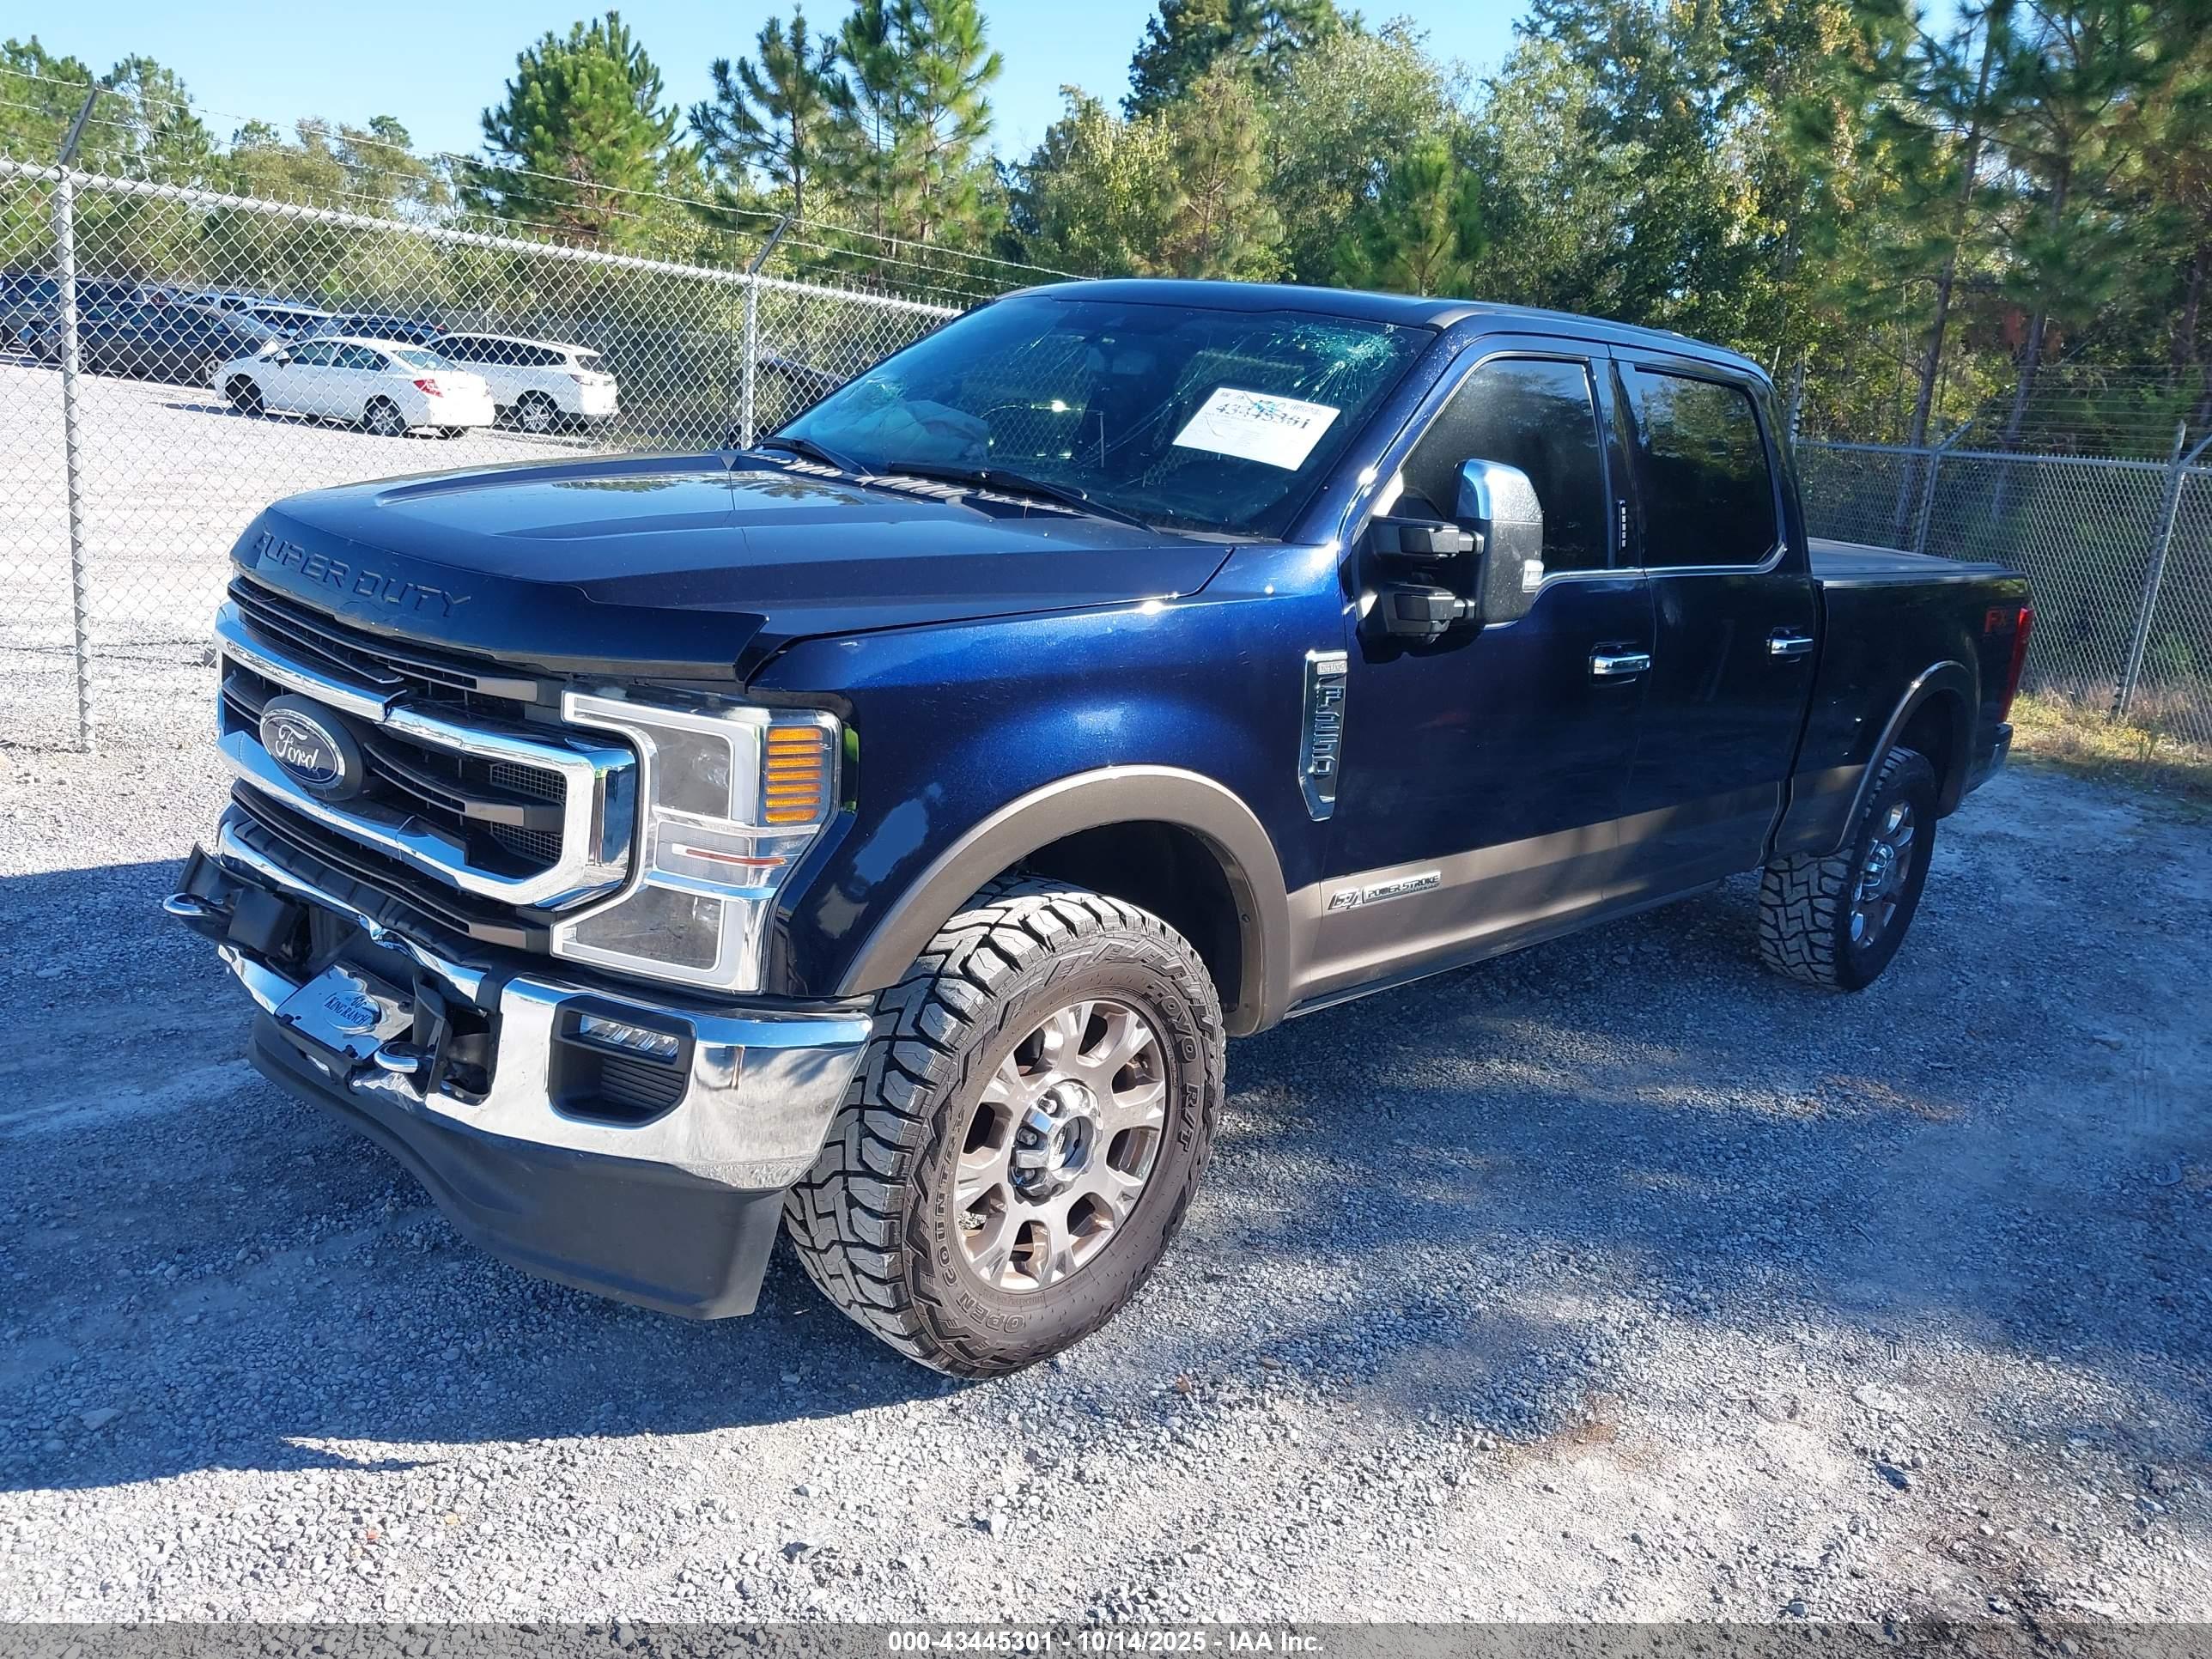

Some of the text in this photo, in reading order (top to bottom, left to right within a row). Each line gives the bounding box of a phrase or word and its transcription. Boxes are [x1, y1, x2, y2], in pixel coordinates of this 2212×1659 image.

[352, 569, 471, 617] DUTY
[275, 724, 319, 769] Ford
[1367, 884, 1401, 899] POWER
[1401, 874, 1440, 891] STROKE
[340, 1006, 372, 1026] RANCH
[1146, 980, 1197, 1062] TOYO
[956, 1290, 1026, 1334] OPEN
